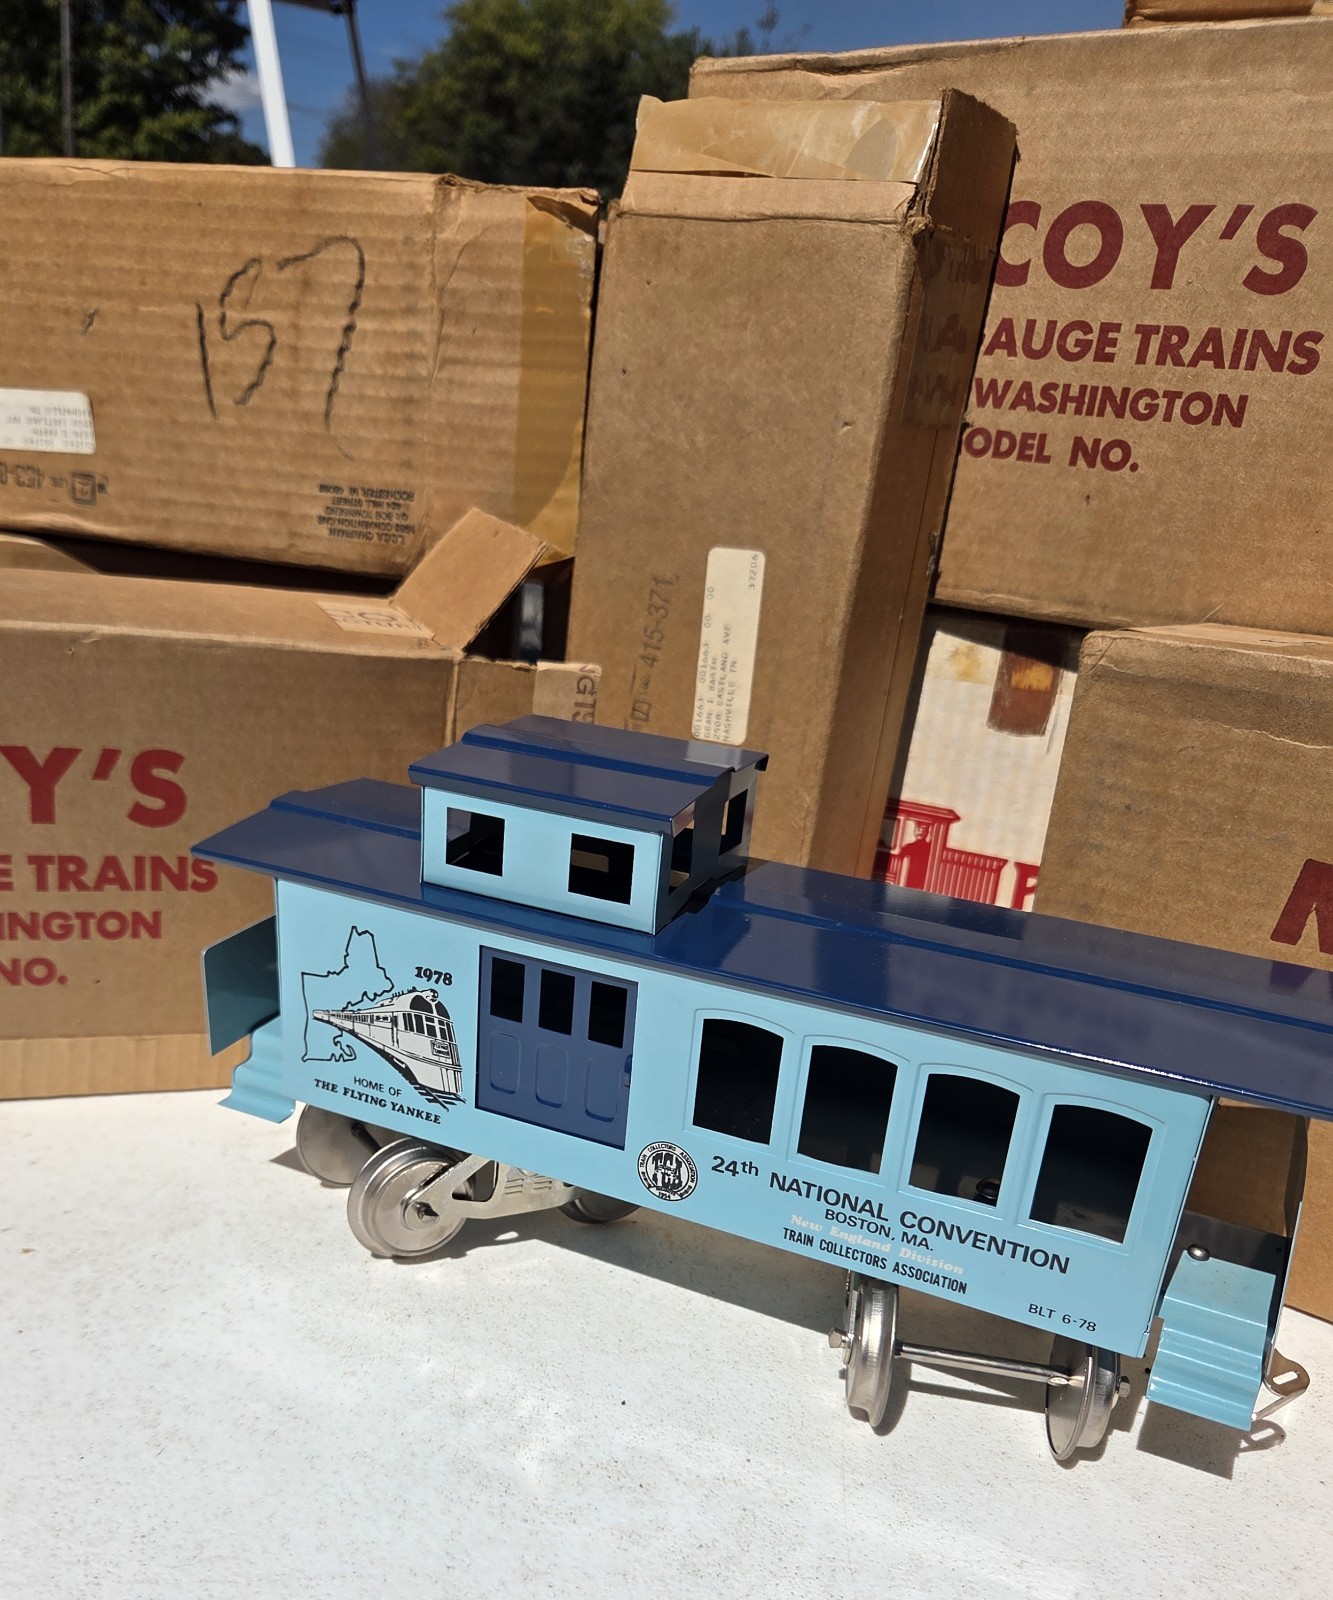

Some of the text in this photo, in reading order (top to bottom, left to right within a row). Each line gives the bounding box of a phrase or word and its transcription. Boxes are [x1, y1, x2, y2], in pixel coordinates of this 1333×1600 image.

[994, 200, 1319, 296] COY'S
[983, 317, 1325, 376] AUGE TRAINS
[973, 377, 1249, 429] WASHINGTON
[963, 426, 1140, 473] ODEL NO.
[748, 554, 759, 590] 37206
[722, 622, 731, 645] AVE
[703, 712, 713, 739] DEAN
[708, 657, 718, 691] BARTH
[716, 652, 729, 707] EASTLAND
[722, 660, 738, 743] NASHVILLE TN
[0, 745, 188, 829] Y'S
[27, 853, 219, 893] TRAINS
[414, 966, 453, 986] 1978
[314, 1078, 442, 1125] THE FLYING YANKEE
[353, 1075, 403, 1097] HOME OF
[711, 1155, 1071, 1275] 24th NATIONAL CONVENTION
[824, 1208, 934, 1252] BOSTON, MA.
[782, 1226, 968, 1295] TRAIN COLLECTORS ASSOCIATION
[790, 1214, 965, 1276] New England Division
[1028, 1303, 1097, 1333] BLT 6-78
